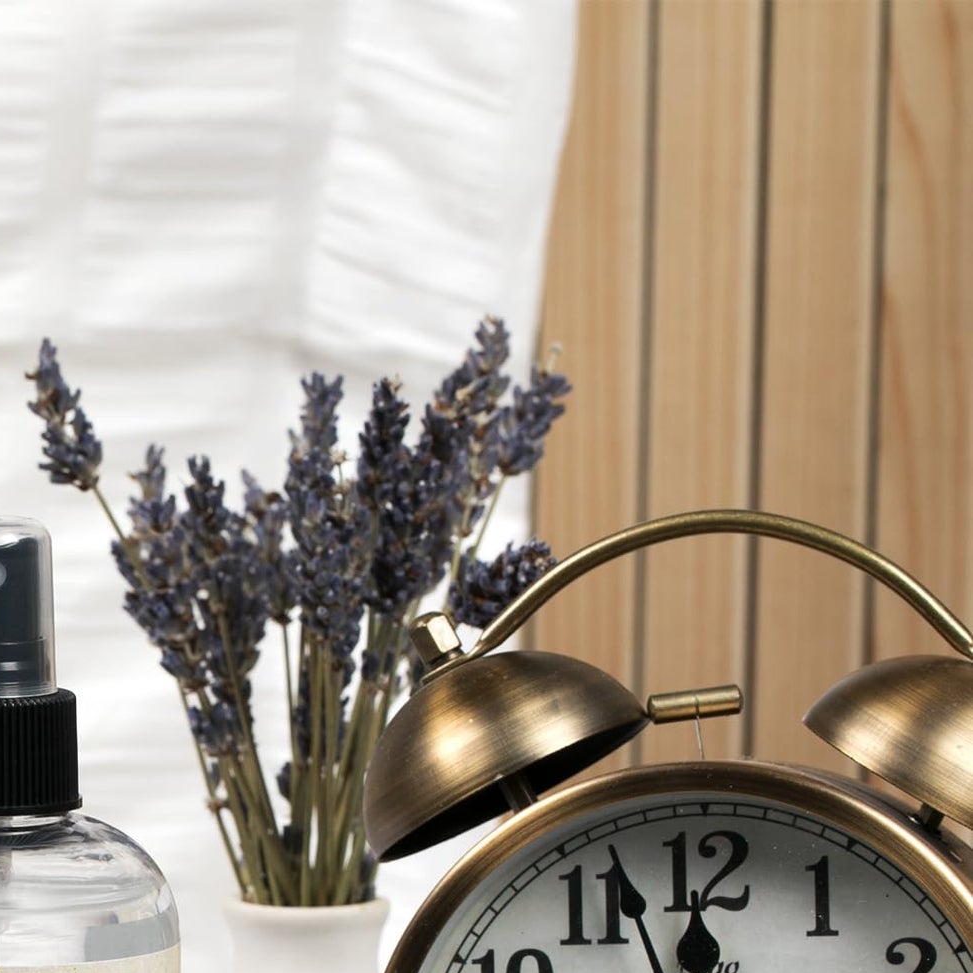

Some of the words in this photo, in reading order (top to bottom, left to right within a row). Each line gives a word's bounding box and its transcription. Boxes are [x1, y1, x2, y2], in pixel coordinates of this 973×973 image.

[558, 864, 629, 945] 11
[662, 830, 751, 912] 12
[805, 855, 839, 937] 1
